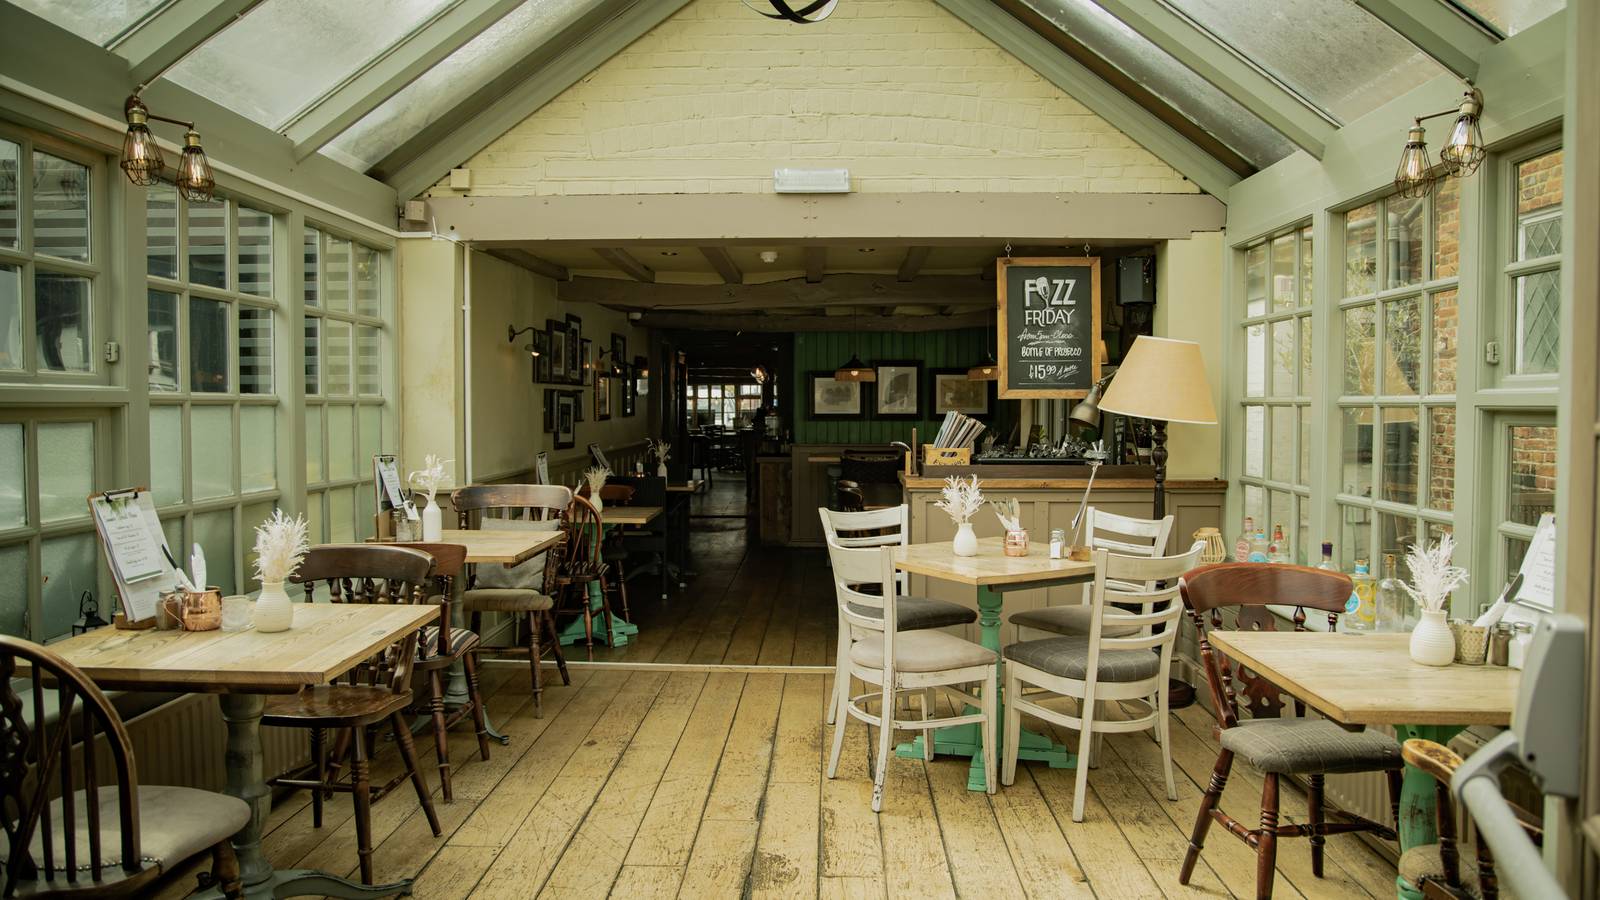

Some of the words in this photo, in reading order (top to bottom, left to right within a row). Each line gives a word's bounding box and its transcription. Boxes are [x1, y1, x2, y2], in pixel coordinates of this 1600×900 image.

[1025, 309, 1075, 327] FRIDAY
[1022, 346, 1043, 357] BOTTLE
[1045, 347, 1053, 357] OF
[1054, 347, 1082, 357] PROSECCO
